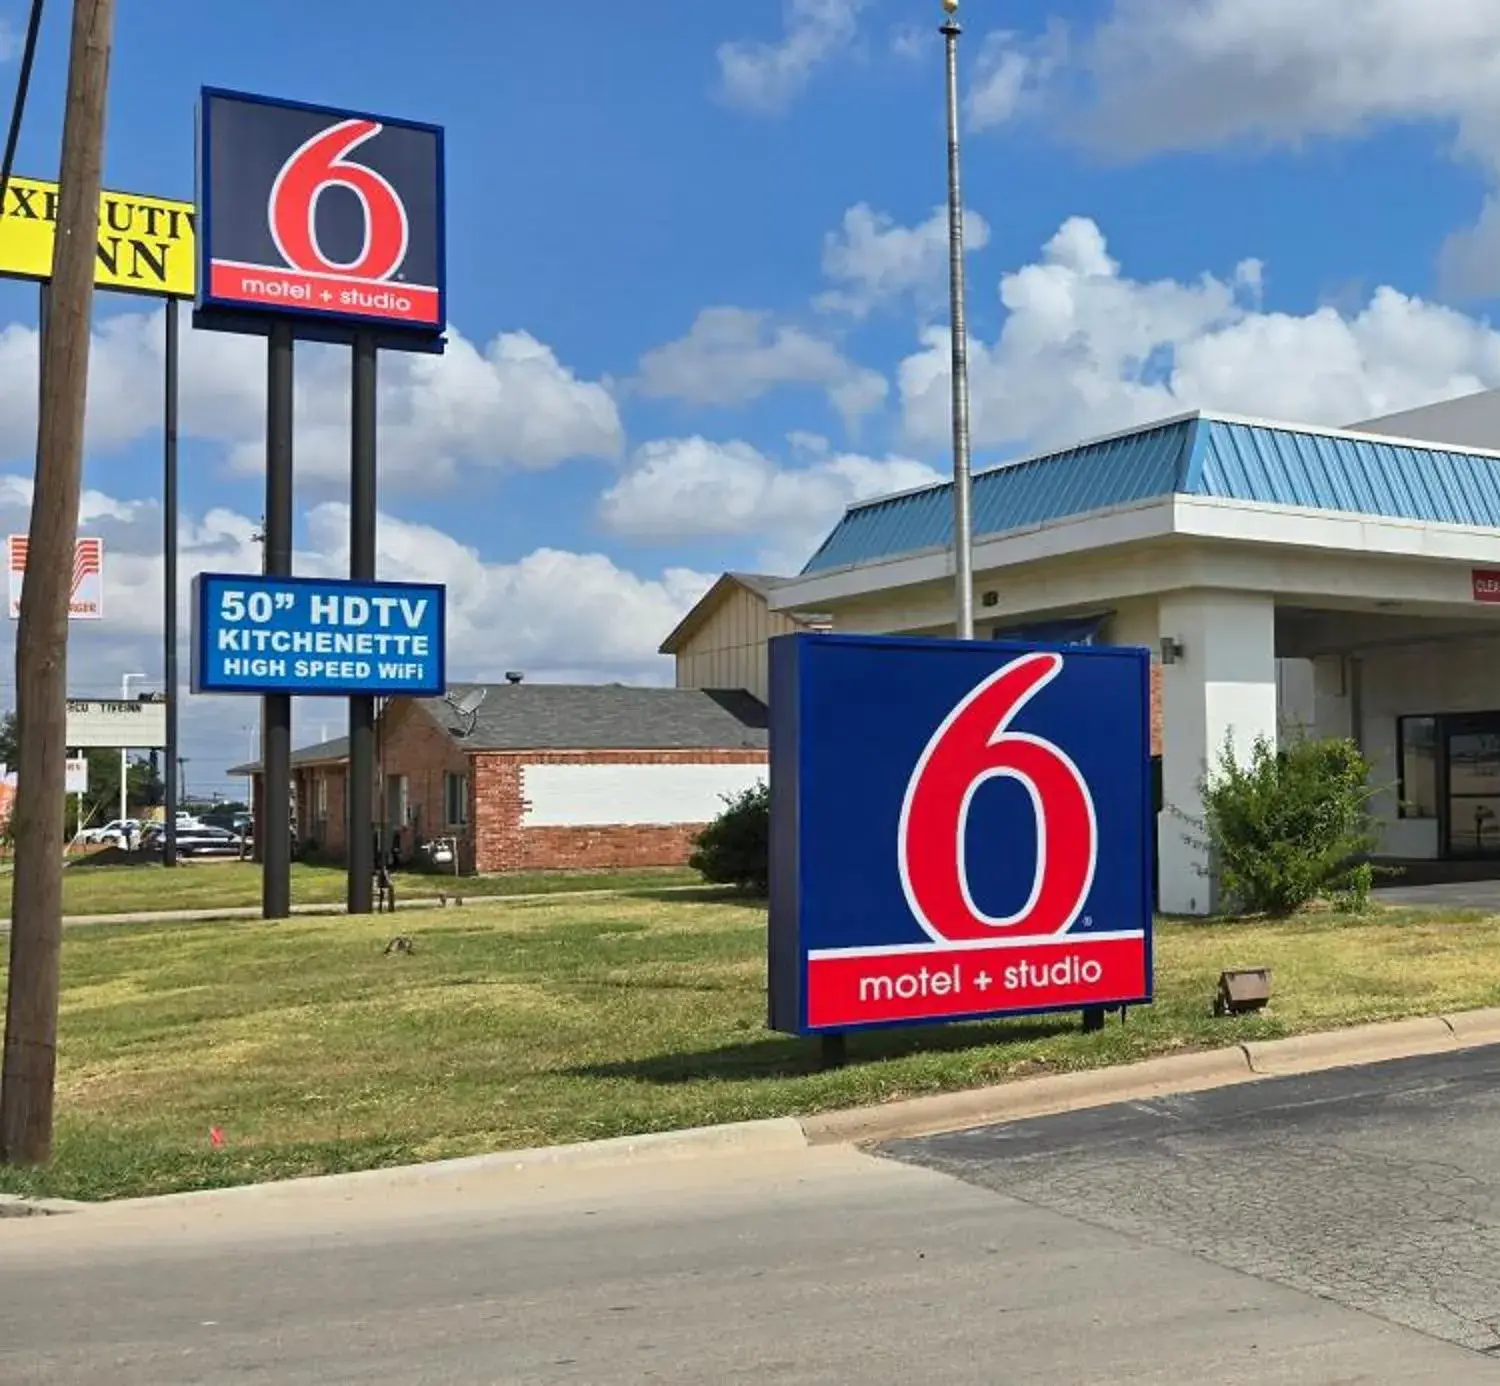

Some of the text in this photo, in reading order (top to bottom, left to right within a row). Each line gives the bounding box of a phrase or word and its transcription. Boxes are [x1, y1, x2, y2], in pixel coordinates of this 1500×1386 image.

[268, 118, 409, 284] 6
[96, 236, 170, 282] NN
[242, 278, 312, 300] motel
[340, 289, 412, 311] studio
[310, 595, 428, 629] HDTV
[217, 628, 429, 656] KITCHENETTE
[223, 658, 424, 680] HIGH SPEED WiFi
[898, 651, 1098, 945] 6
[860, 964, 961, 1001] motel
[1003, 955, 1102, 990] studio
